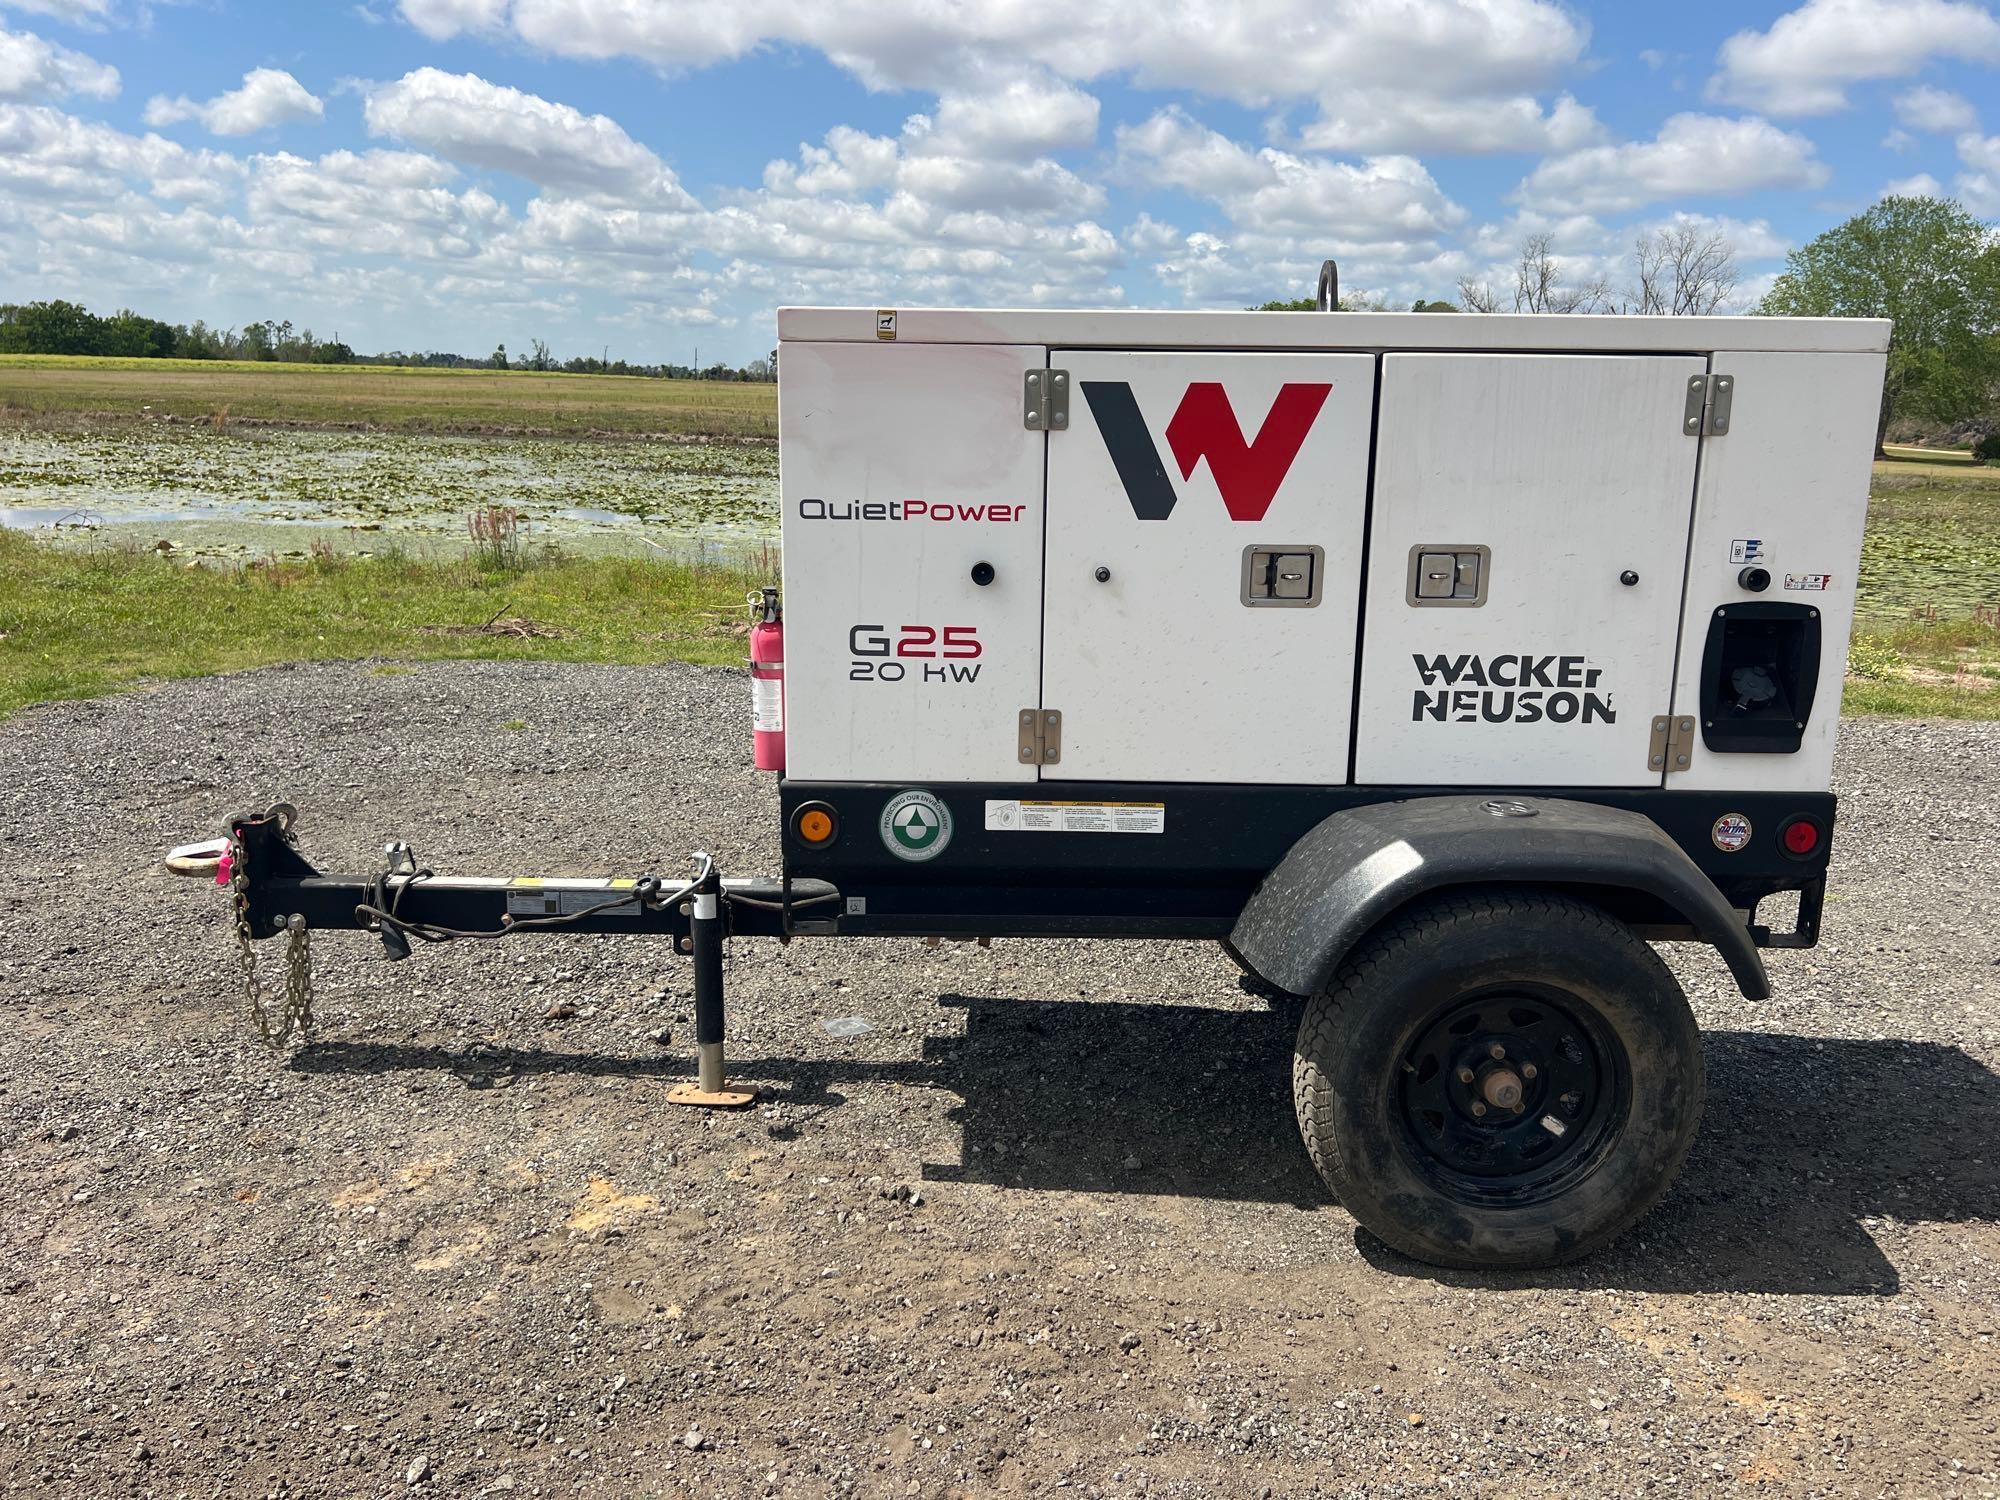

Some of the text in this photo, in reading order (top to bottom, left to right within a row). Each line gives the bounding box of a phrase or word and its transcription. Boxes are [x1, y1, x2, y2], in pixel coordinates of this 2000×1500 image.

[799, 499, 1026, 522] QuietPower
[849, 624, 983, 659] G25
[849, 661, 906, 682] 20
[1411, 690, 1617, 724] NEUSON
[884, 797, 906, 829] PROTECTING
